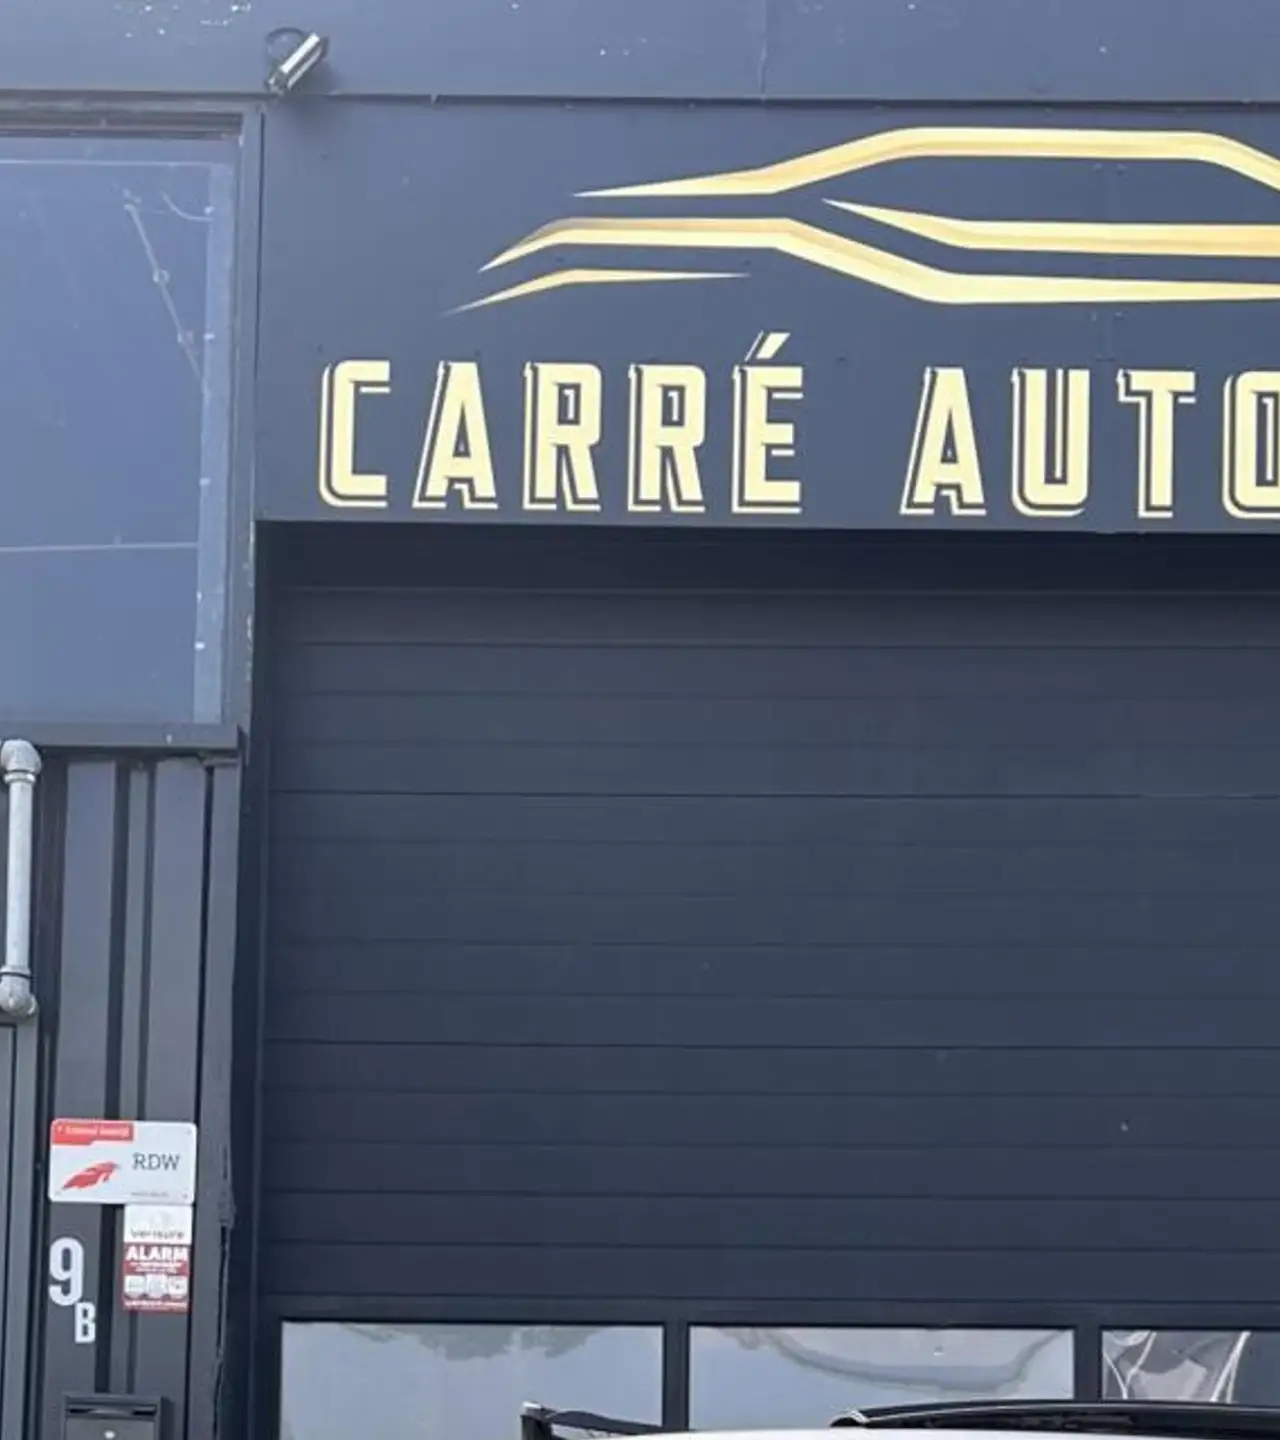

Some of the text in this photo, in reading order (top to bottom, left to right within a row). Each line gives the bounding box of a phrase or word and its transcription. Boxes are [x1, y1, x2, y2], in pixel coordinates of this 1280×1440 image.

[319, 332, 805, 514] CARRÉ
[131, 1152, 181, 1171] RDW
[126, 1245, 189, 1262] ALARM
[48, 1237, 97, 1344] 9 B
